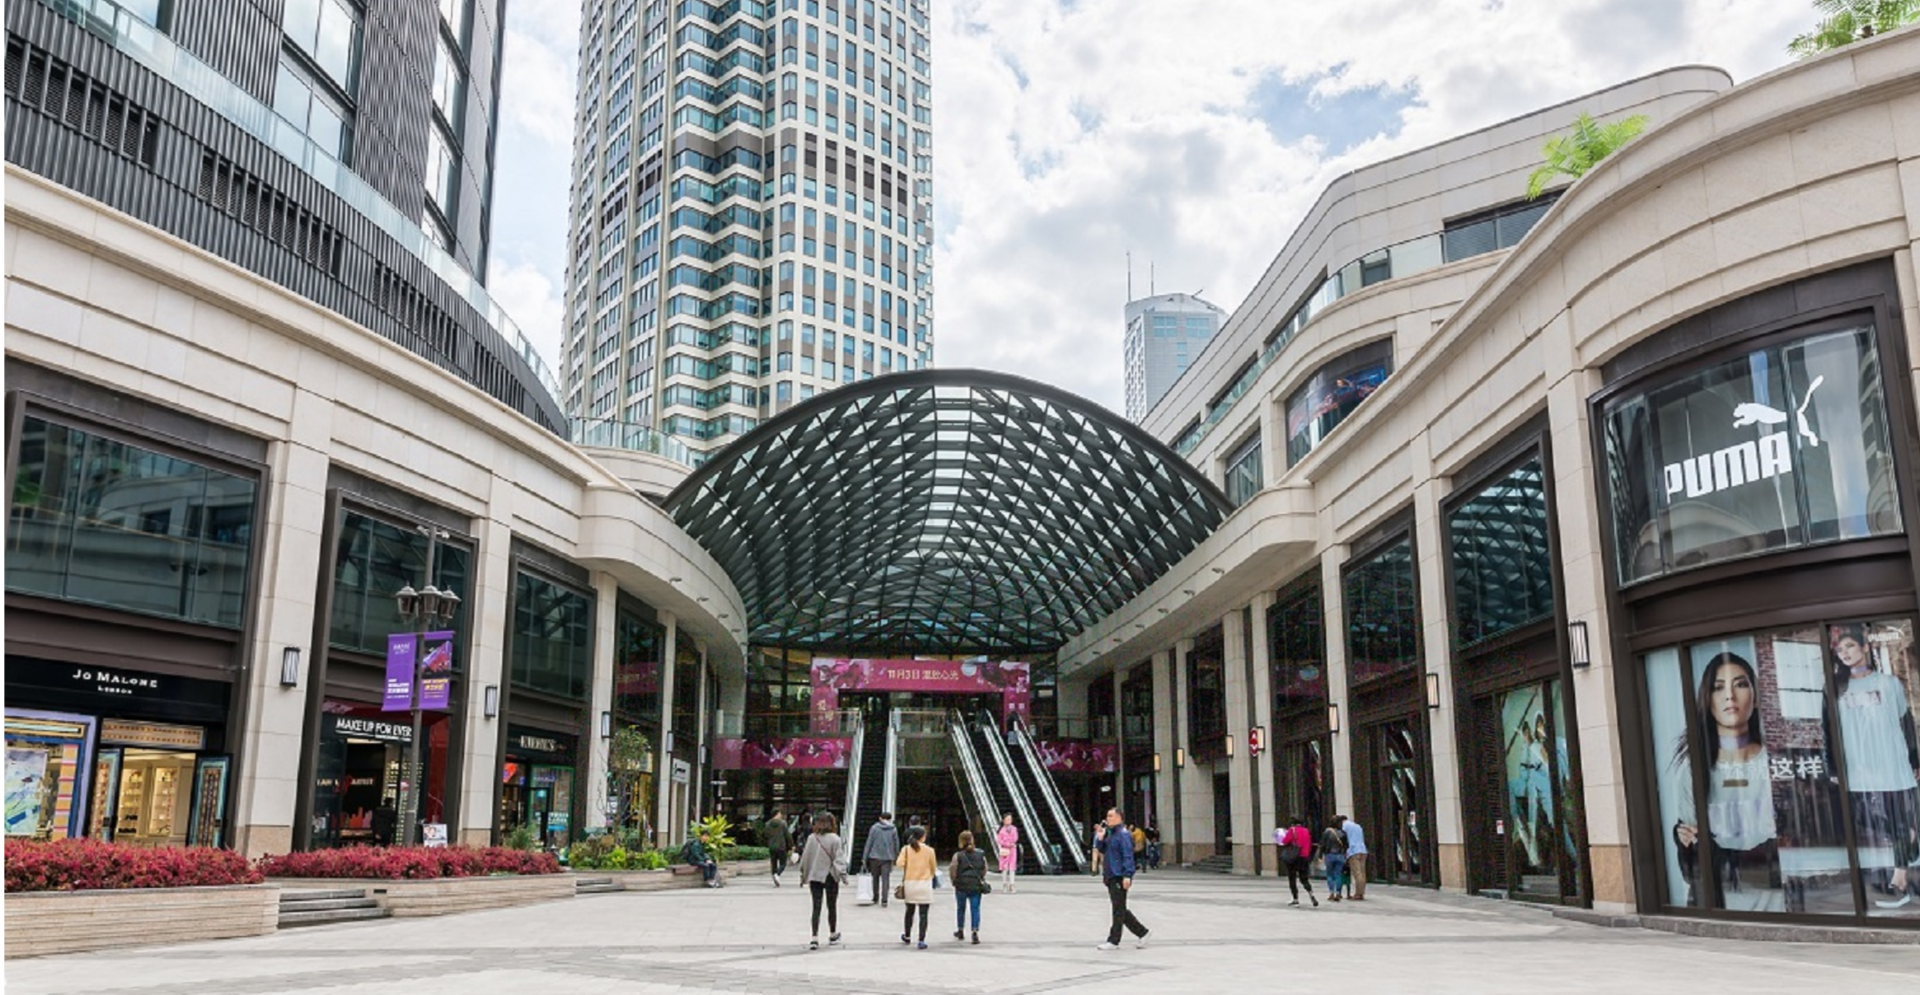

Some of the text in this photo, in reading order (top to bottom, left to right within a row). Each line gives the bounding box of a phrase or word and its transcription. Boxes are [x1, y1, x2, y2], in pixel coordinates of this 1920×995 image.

[1664, 432, 1792, 503] PUMA
[97, 671, 158, 688] MALONE
[335, 717, 412, 737] MAKE UP FOR EVER
